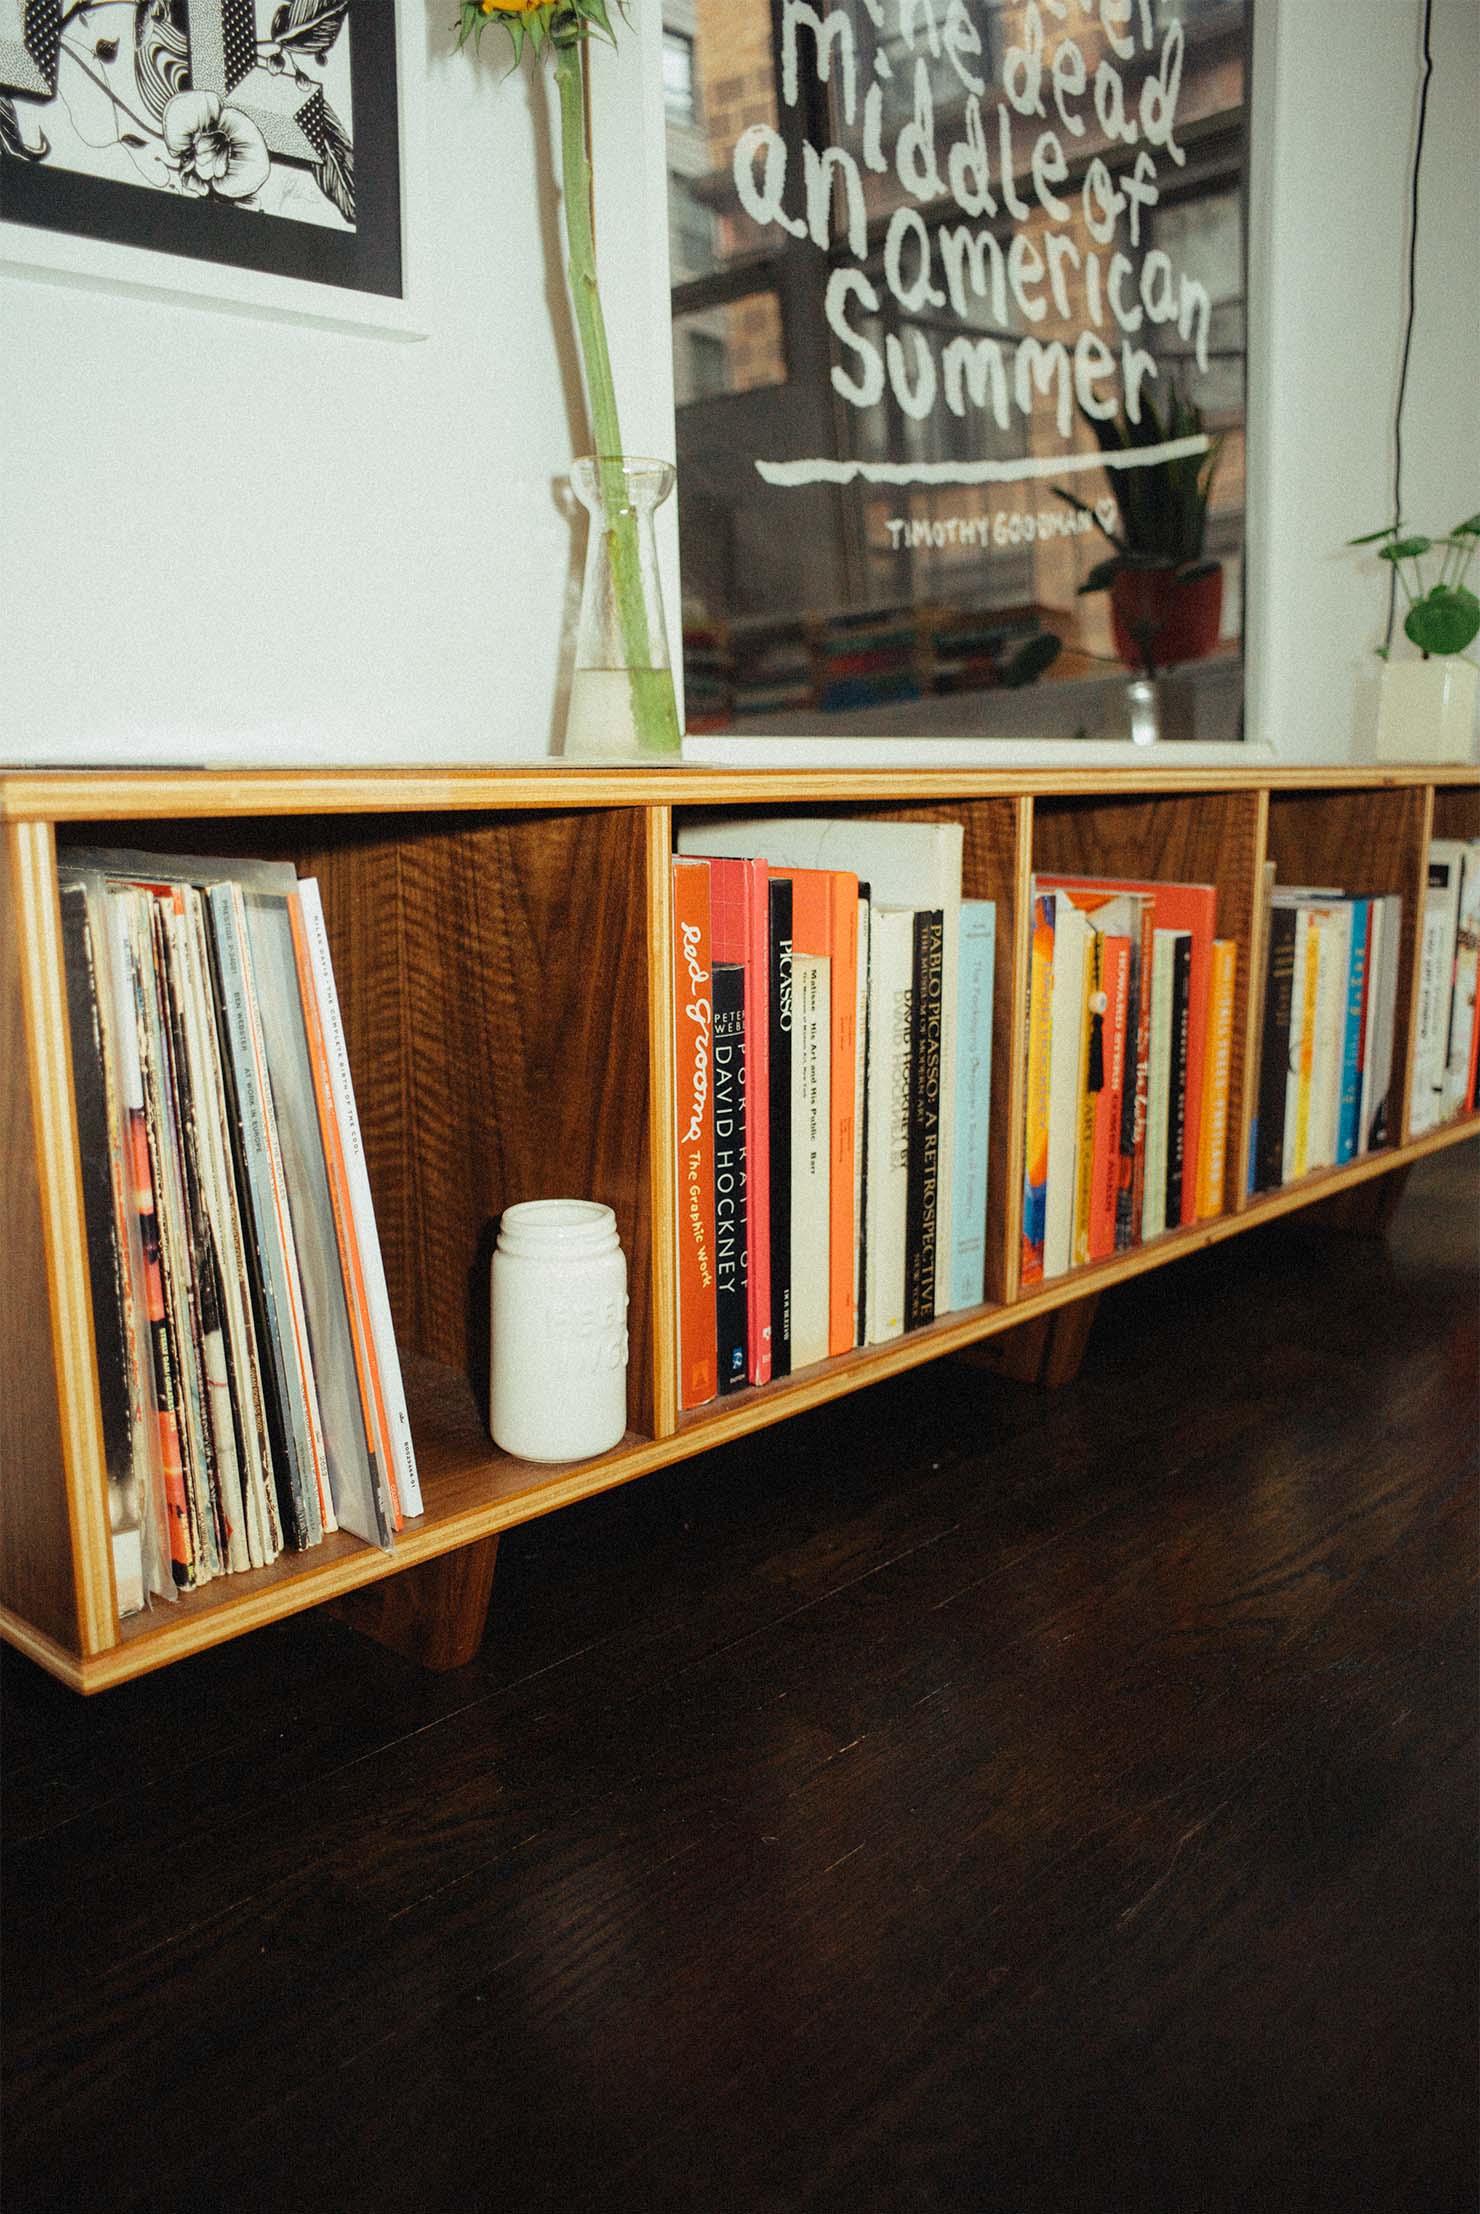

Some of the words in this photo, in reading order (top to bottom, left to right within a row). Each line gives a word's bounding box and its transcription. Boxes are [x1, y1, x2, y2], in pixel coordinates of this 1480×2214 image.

[1003, 0, 1186, 166] dead
[782, 0, 1072, 221] middle
[1083, 152, 1159, 247] of
[734, 123, 867, 260] an
[885, 207, 1212, 373] american
[825, 268, 1158, 438] Summer
[884, 516, 990, 550] TIMOTHY
[993, 511, 1095, 547] GOODMAN
[680, 921, 710, 996] Red
[920, 927, 929, 953] THE
[928, 924, 942, 998] PABLO
[779, 938, 793, 1033] PICASSO
[919, 957, 929, 1016] MUSEUM
[919, 1018, 928, 1035] OF
[926, 1002, 942, 1105] PICASSO:
[715, 1045, 734, 1138] DAVID
[917, 1039, 928, 1096] MODERN
[251, 1120, 262, 1153] EUROPE
[925, 1111, 938, 1128] A
[688, 1150, 702, 1181] The
[687, 1185, 704, 1244] Graphic
[716, 1149, 736, 1293] HOCKNEY
[920, 1134, 938, 1318] RETROSPECTIVE
[696, 1246, 713, 1289] Work
